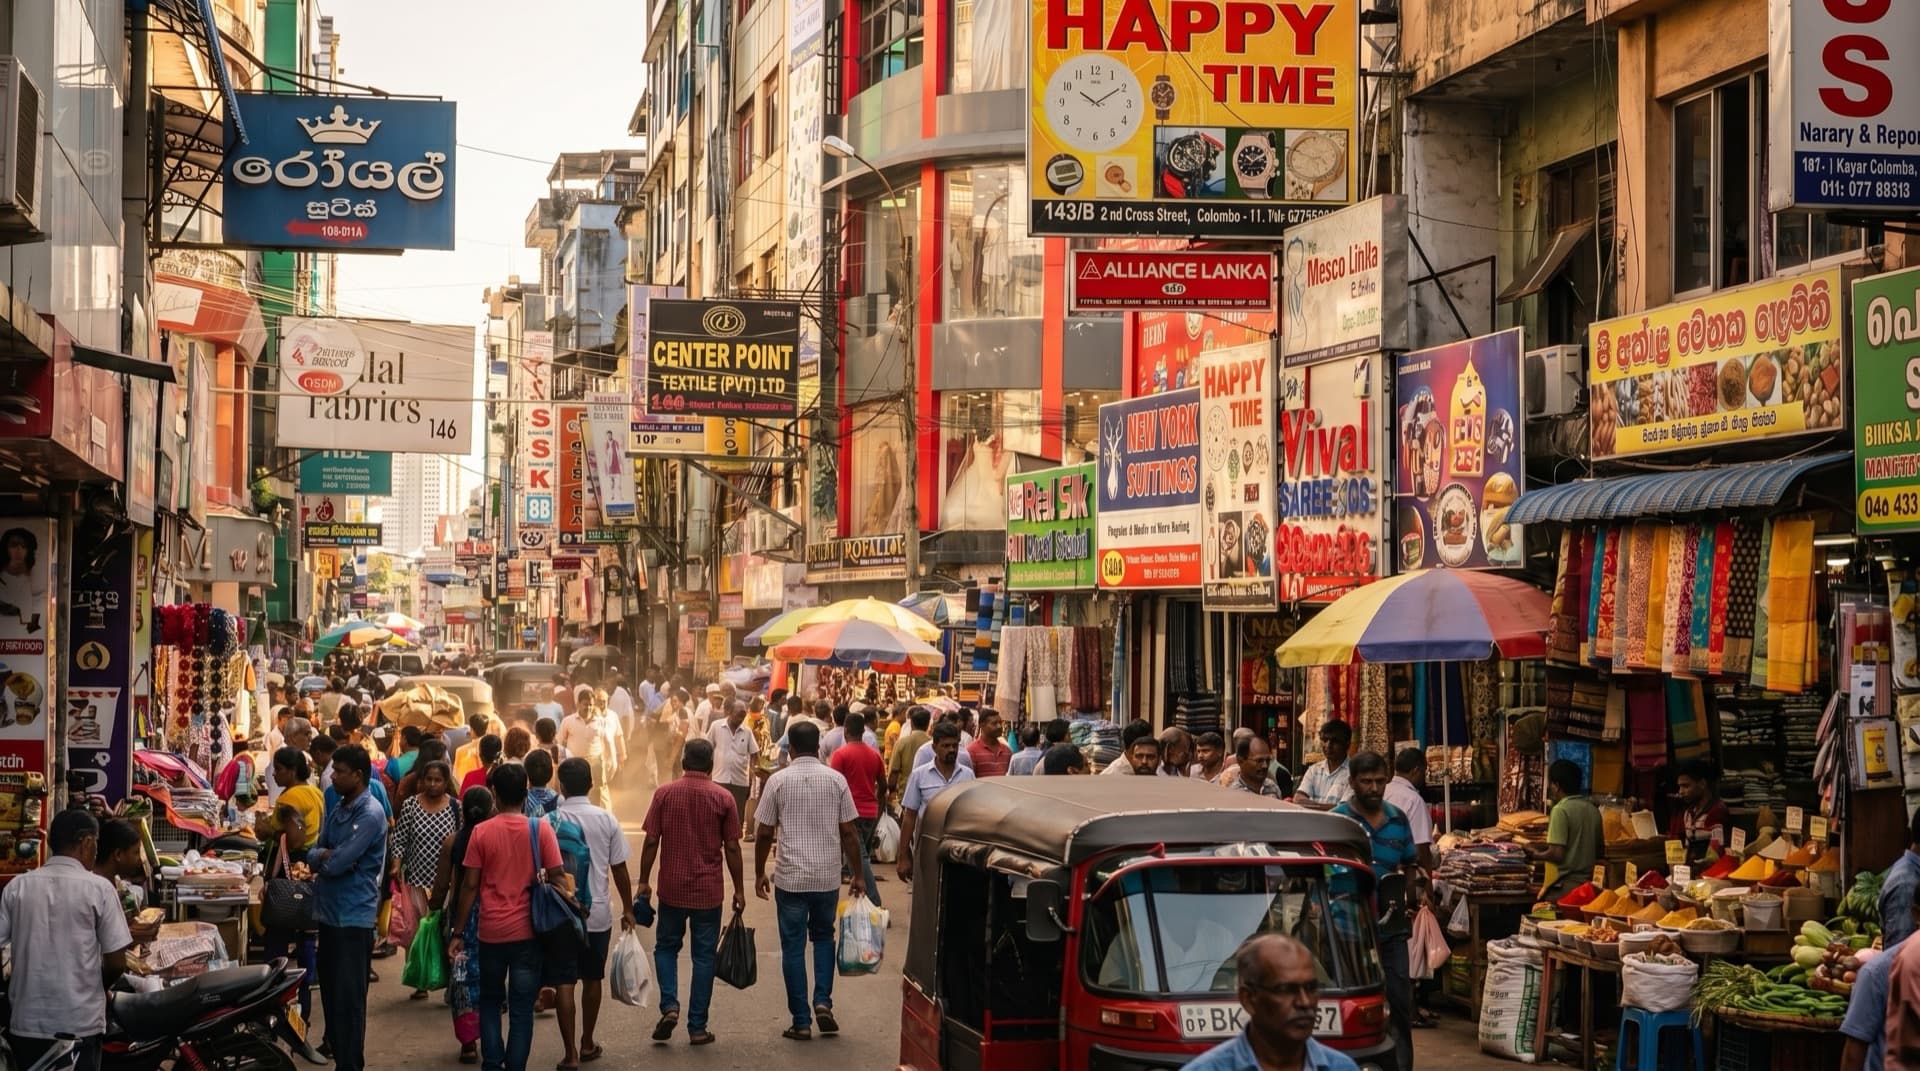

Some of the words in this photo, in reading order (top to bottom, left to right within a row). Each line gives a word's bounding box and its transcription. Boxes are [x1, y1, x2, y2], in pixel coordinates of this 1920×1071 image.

[1046, 0, 1335, 56] HAPPY
[1075, 69, 1082, 80] 11
[1090, 65, 1101, 75] 12
[1110, 70, 1114, 80] 1
[1063, 81, 1072, 91] 10
[1121, 83, 1127, 92] 2
[1202, 63, 1336, 105] TIME
[1059, 98, 1065, 107] 9
[1126, 99, 1132, 109] 3
[1063, 115, 1070, 125] 8
[1121, 115, 1127, 125] 4
[1076, 127, 1082, 137] 7
[1092, 132, 1098, 141] 6
[1110, 128, 1116, 137] 5
[1800, 121, 1854, 148] Narary
[1859, 124, 1871, 143] &
[1836, 158, 1867, 178] Kayar
[1870, 159, 1917, 176] Colomba,
[1821, 180, 1844, 197] 011:
[1849, 181, 1872, 198] 077
[1876, 181, 1911, 199] 88313
[1044, 202, 1095, 223] 143/B
[1100, 208, 1108, 221] 2
[1110, 207, 1123, 221] nd
[1125, 207, 1154, 222] Cross
[1157, 207, 1191, 225] Street,
[1197, 207, 1240, 223] Colombo
[1103, 261, 1197, 280] ALLIANCE
[1201, 263, 1267, 280] LANKA
[1306, 256, 1345, 288] Mesco
[653, 341, 730, 368] CENTER
[735, 344, 794, 370] POINT
[660, 374, 717, 392] TEXTILE
[720, 375, 756, 398] (PVT)
[759, 377, 785, 394] LTD
[1204, 358, 1265, 398] HAPPY
[1229, 399, 1262, 428] TIME
[429, 419, 457, 439] 146
[1127, 409, 1158, 454] NEW
[1159, 402, 1199, 450] YORK
[1281, 400, 1369, 477] Vival
[1279, 478, 1333, 517] SAREE
[1893, 492, 1918, 516] 433
[529, 498, 551, 519] 8B
[1210, 1007, 1243, 1031] BK
